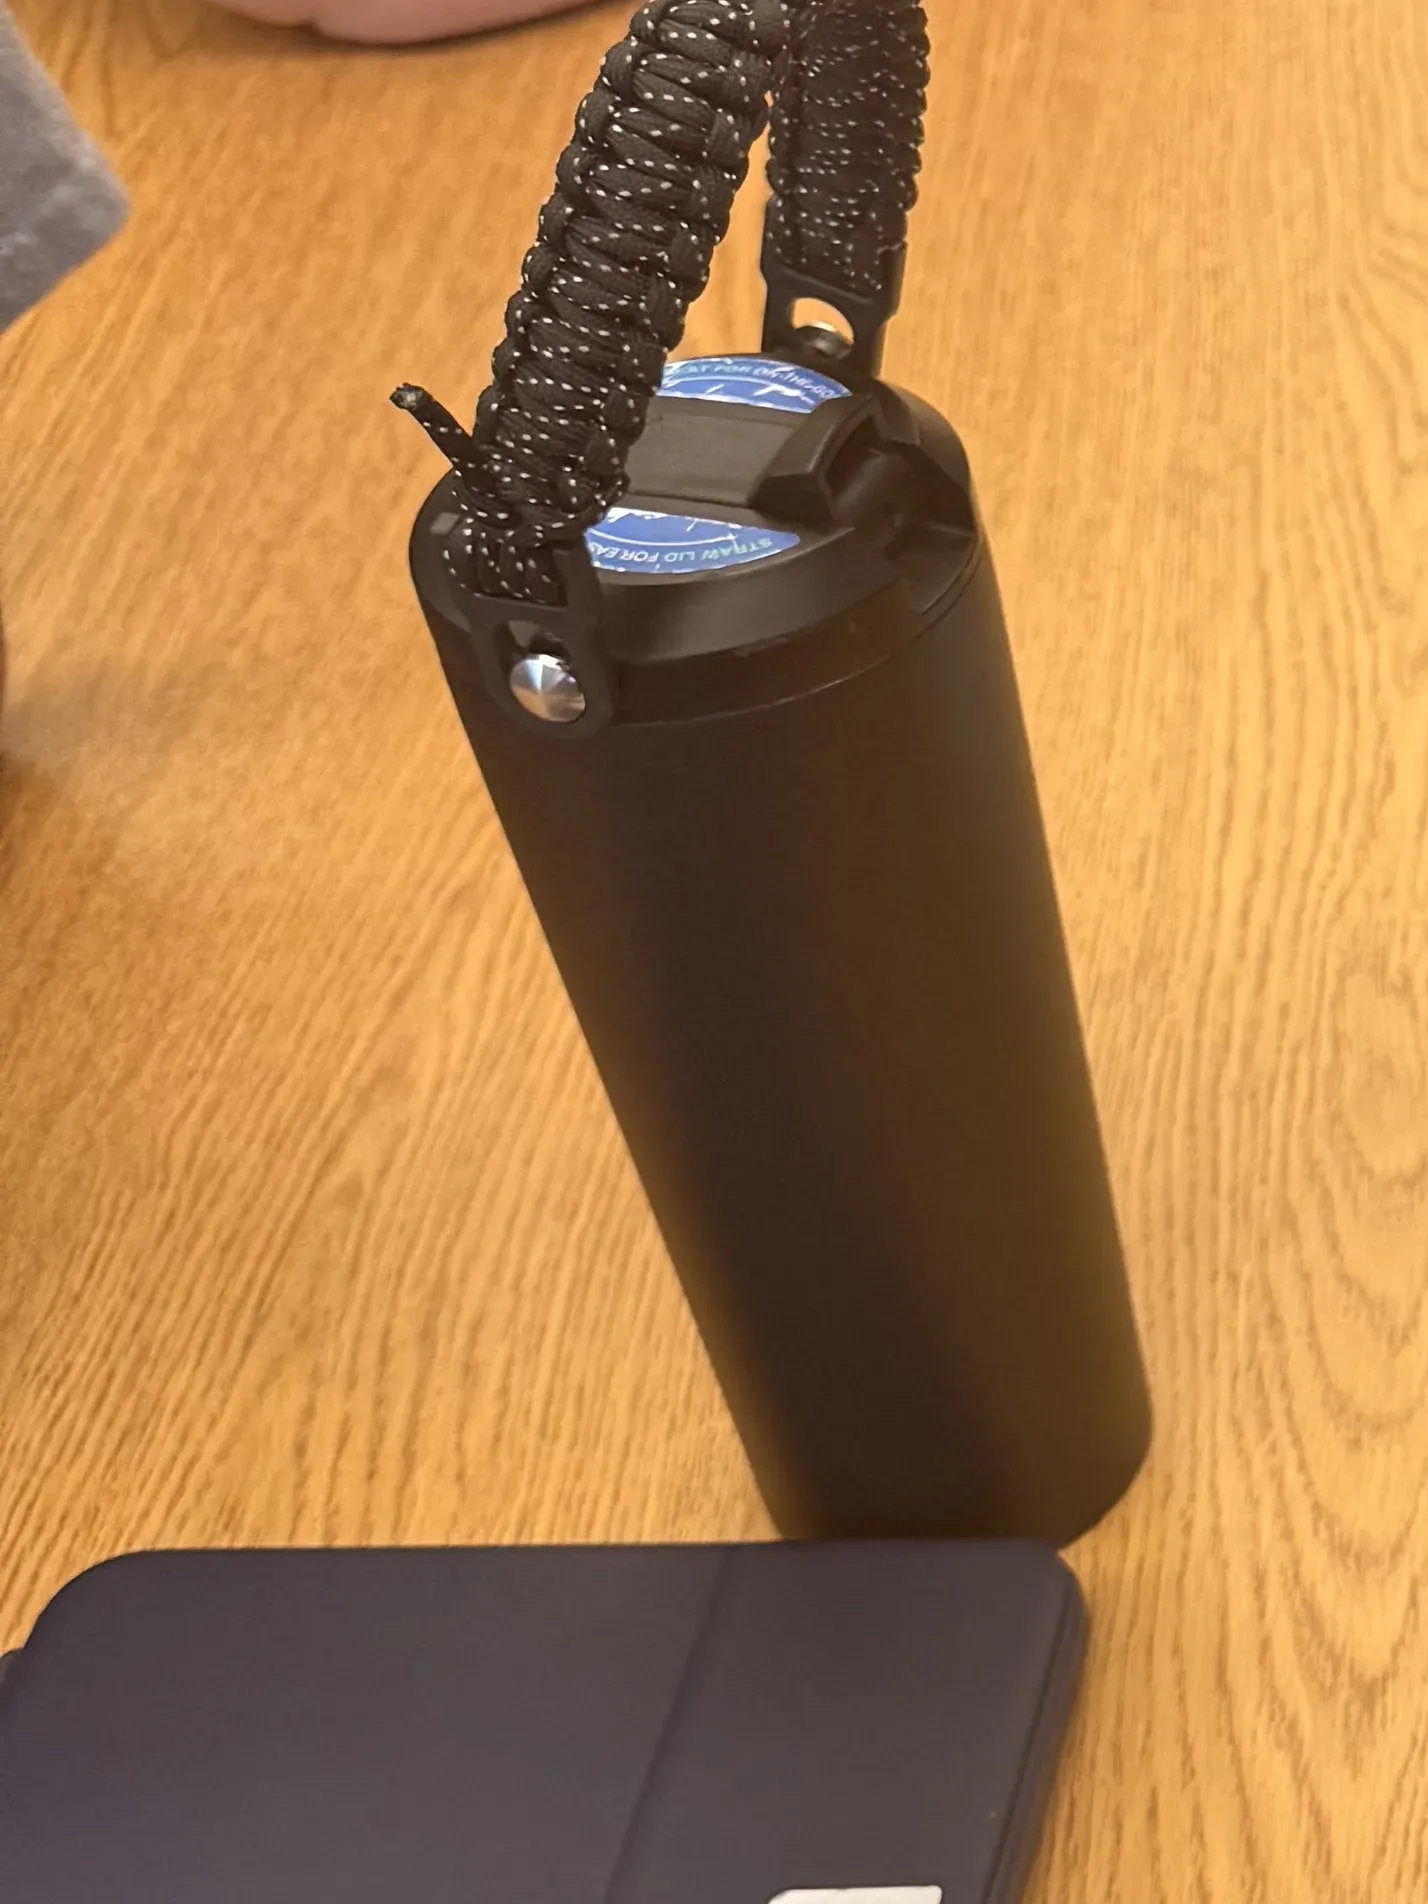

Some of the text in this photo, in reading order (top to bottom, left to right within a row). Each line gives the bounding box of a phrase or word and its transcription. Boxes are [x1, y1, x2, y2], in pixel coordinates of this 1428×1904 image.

[620, 549, 660, 563] FOR
[664, 550, 695, 562] LID
[701, 537, 773, 561] STRAW
